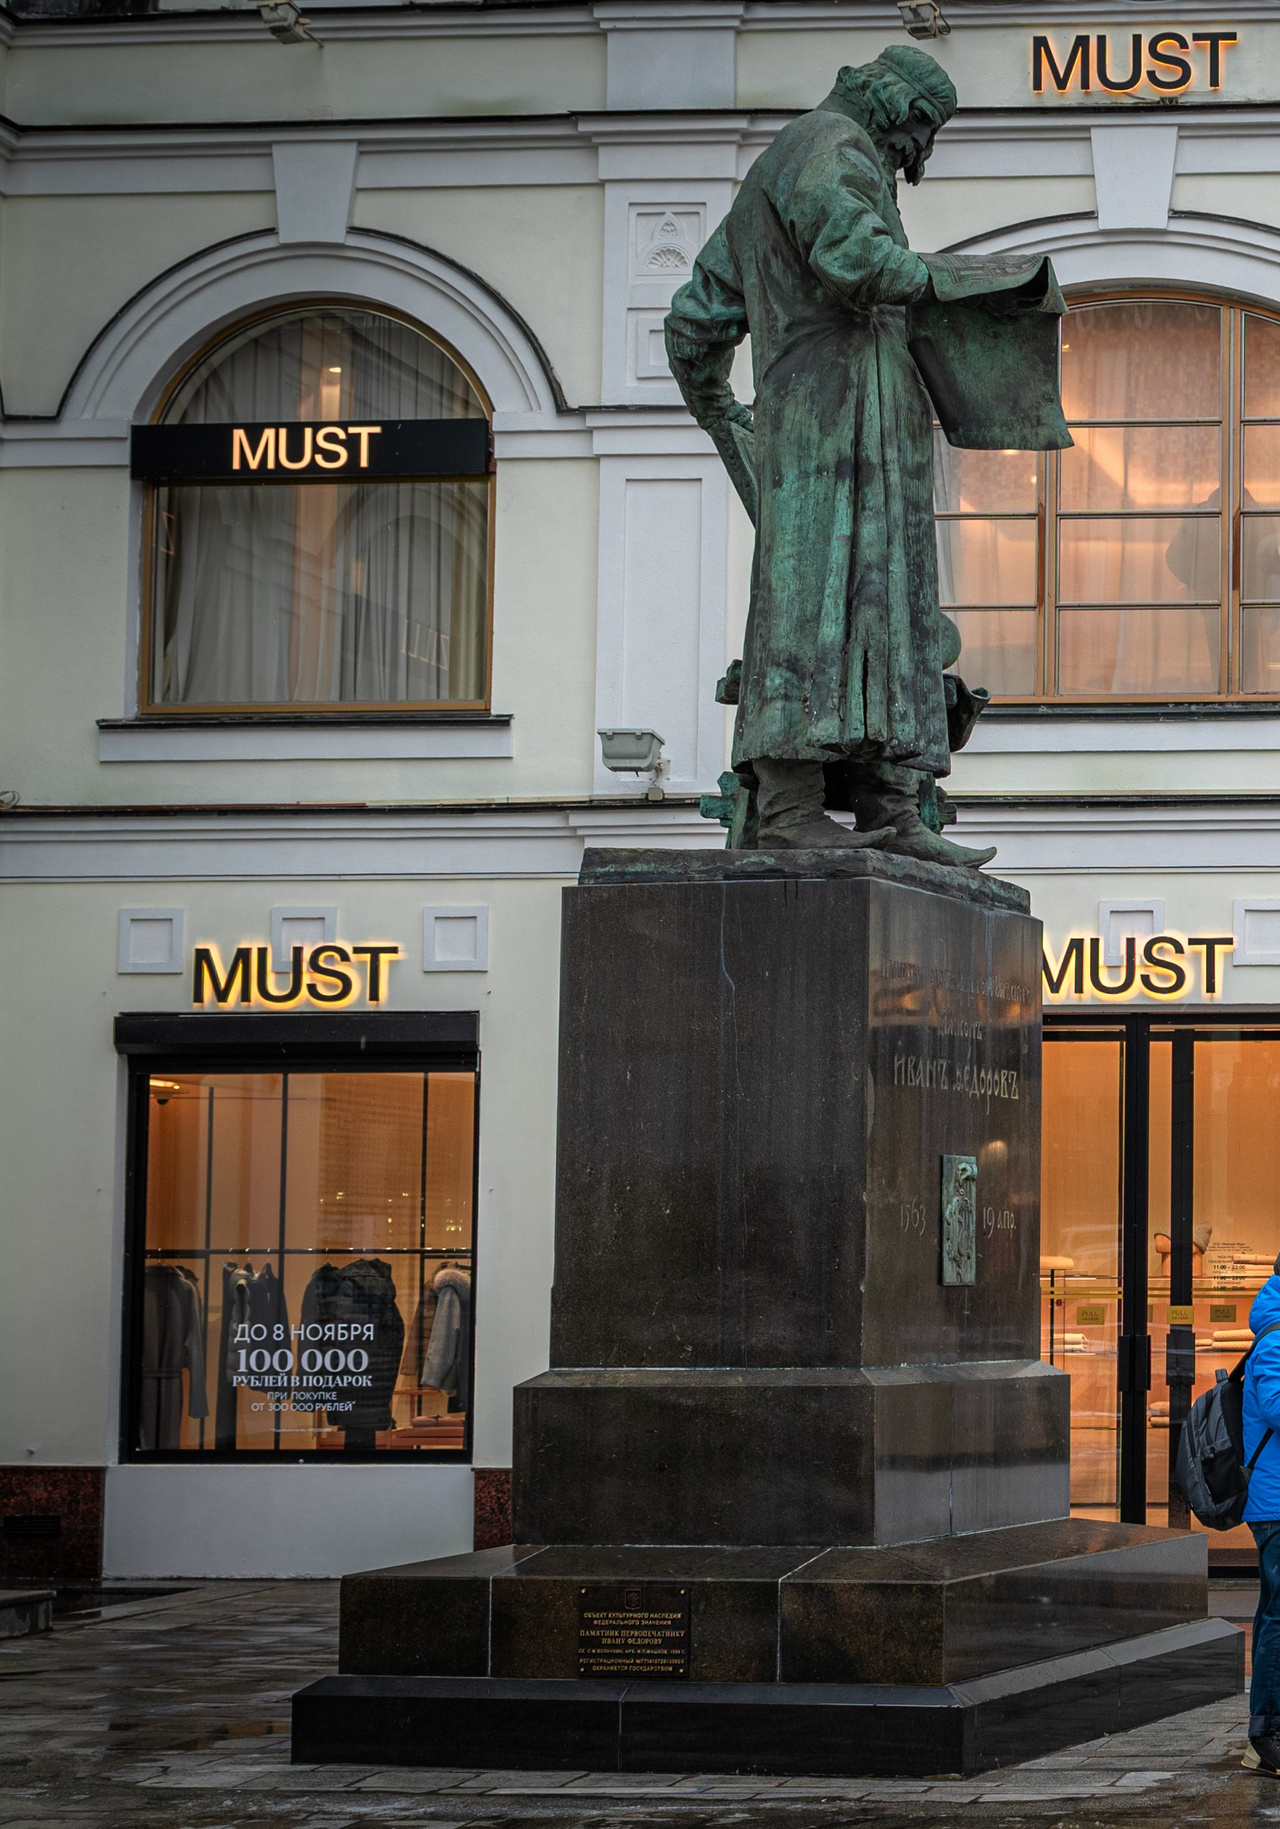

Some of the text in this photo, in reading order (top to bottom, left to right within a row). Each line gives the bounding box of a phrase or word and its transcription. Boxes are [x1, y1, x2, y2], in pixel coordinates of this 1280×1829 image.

[1033, 32, 1238, 91] MUST
[232, 426, 382, 470] MUST
[193, 946, 399, 1004] MUST
[1042, 937, 1234, 995] MUST
[983, 1207, 995, 1239] 19
[234, 1323, 374, 1344] ДО 8 НОЯБРЯ
[237, 1348, 369, 1373] 100 000
[232, 1373, 373, 1389] РУБЛЕЙ В ПОДАРОК
[251, 1403, 265, 1412] ОТ
[268, 1403, 289, 1412] 300
[290, 1403, 314, 1412] 000
[267, 1391, 337, 1400] ПРИ ПОКУПКЕ
